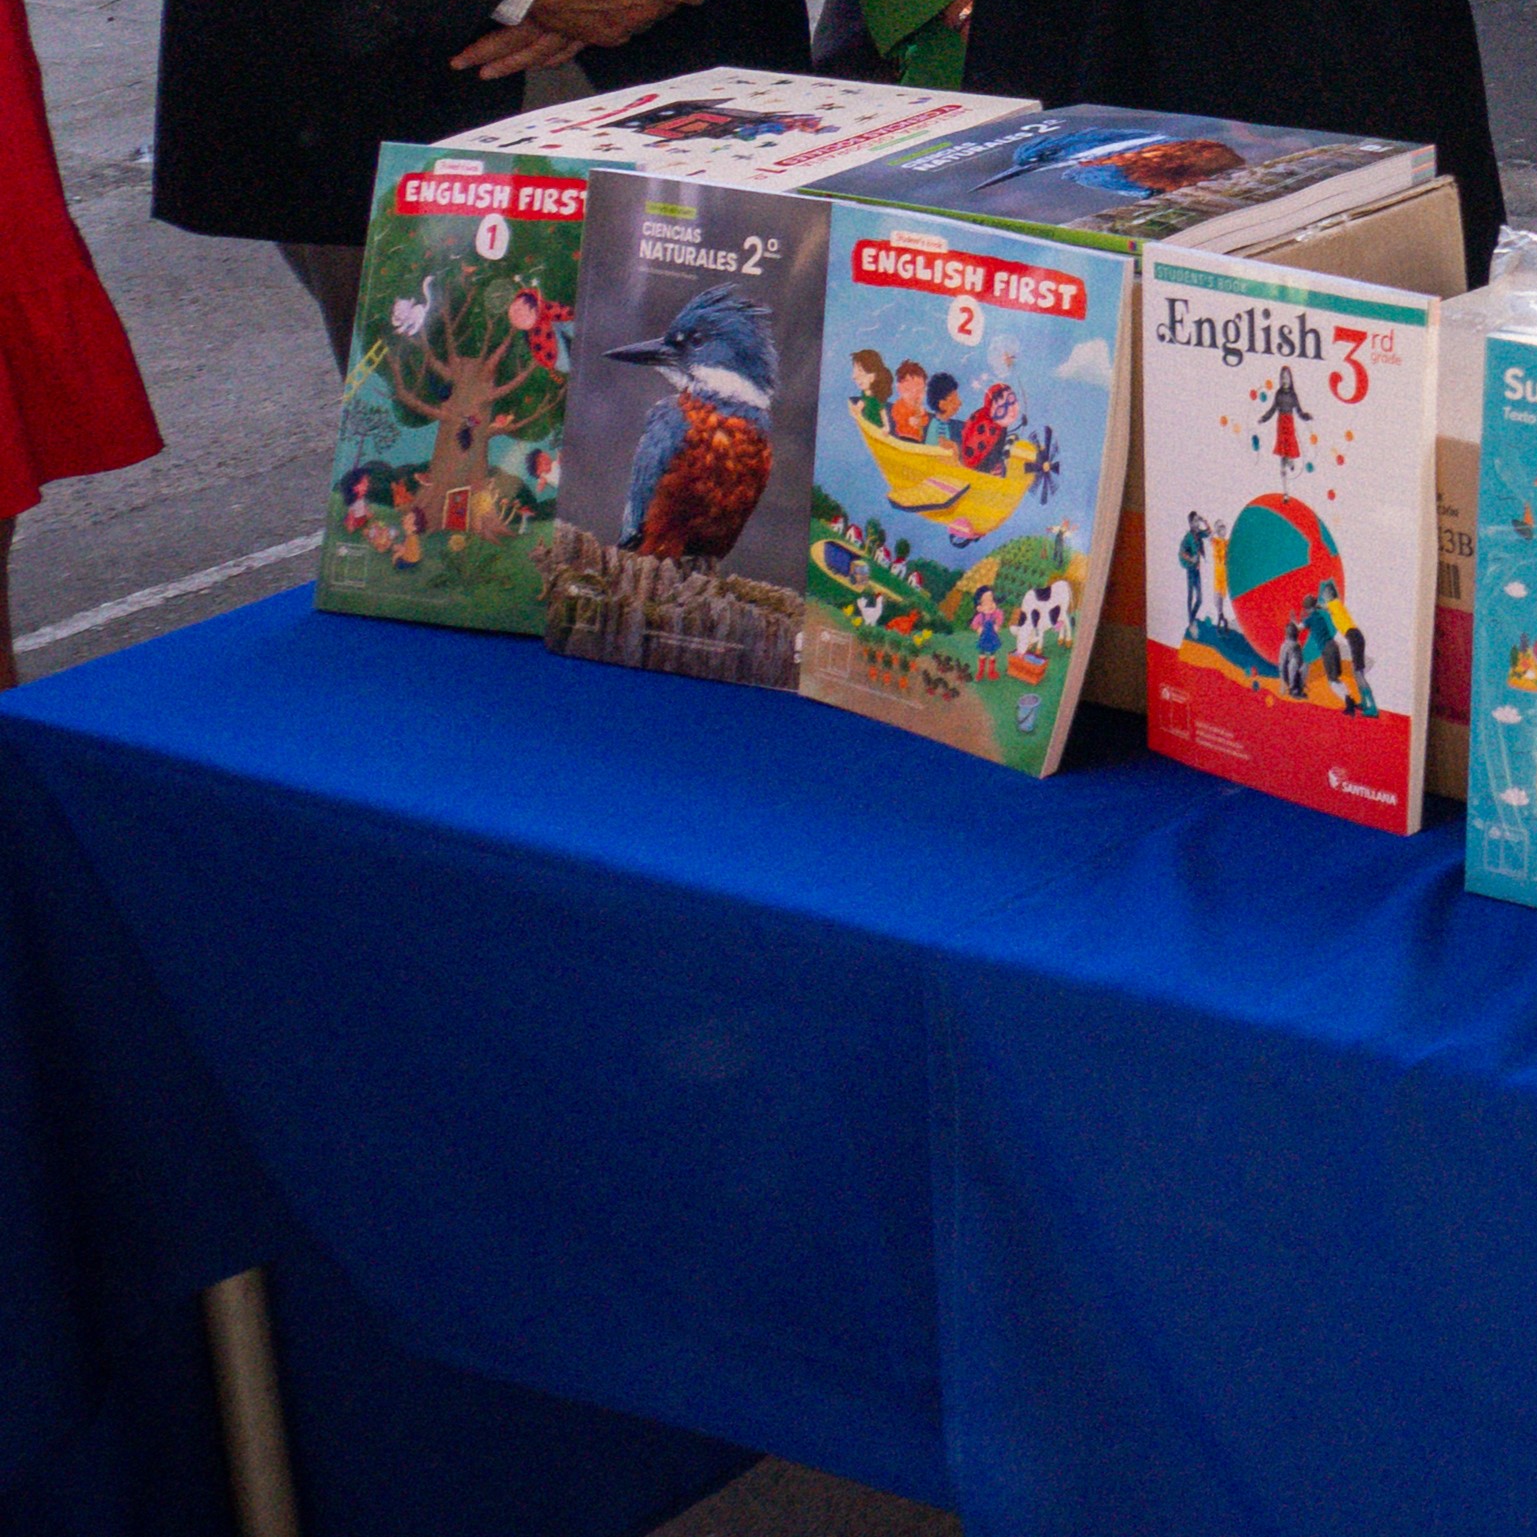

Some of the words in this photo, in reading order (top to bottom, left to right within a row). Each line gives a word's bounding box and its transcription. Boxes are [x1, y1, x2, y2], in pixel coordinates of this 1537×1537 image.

[405, 180, 511, 209] ENGLISH
[518, 186, 587, 215] FIRS
[486, 224, 497, 250] 1
[642, 221, 702, 244] CIENCIAS
[639, 239, 738, 272] NATURALES
[861, 247, 986, 292] ENGLISH
[993, 272, 1078, 310] FIRST
[957, 306, 975, 335] 2
[1156, 297, 1325, 367] English
[1341, 781, 1398, 806] SANTILLANA
